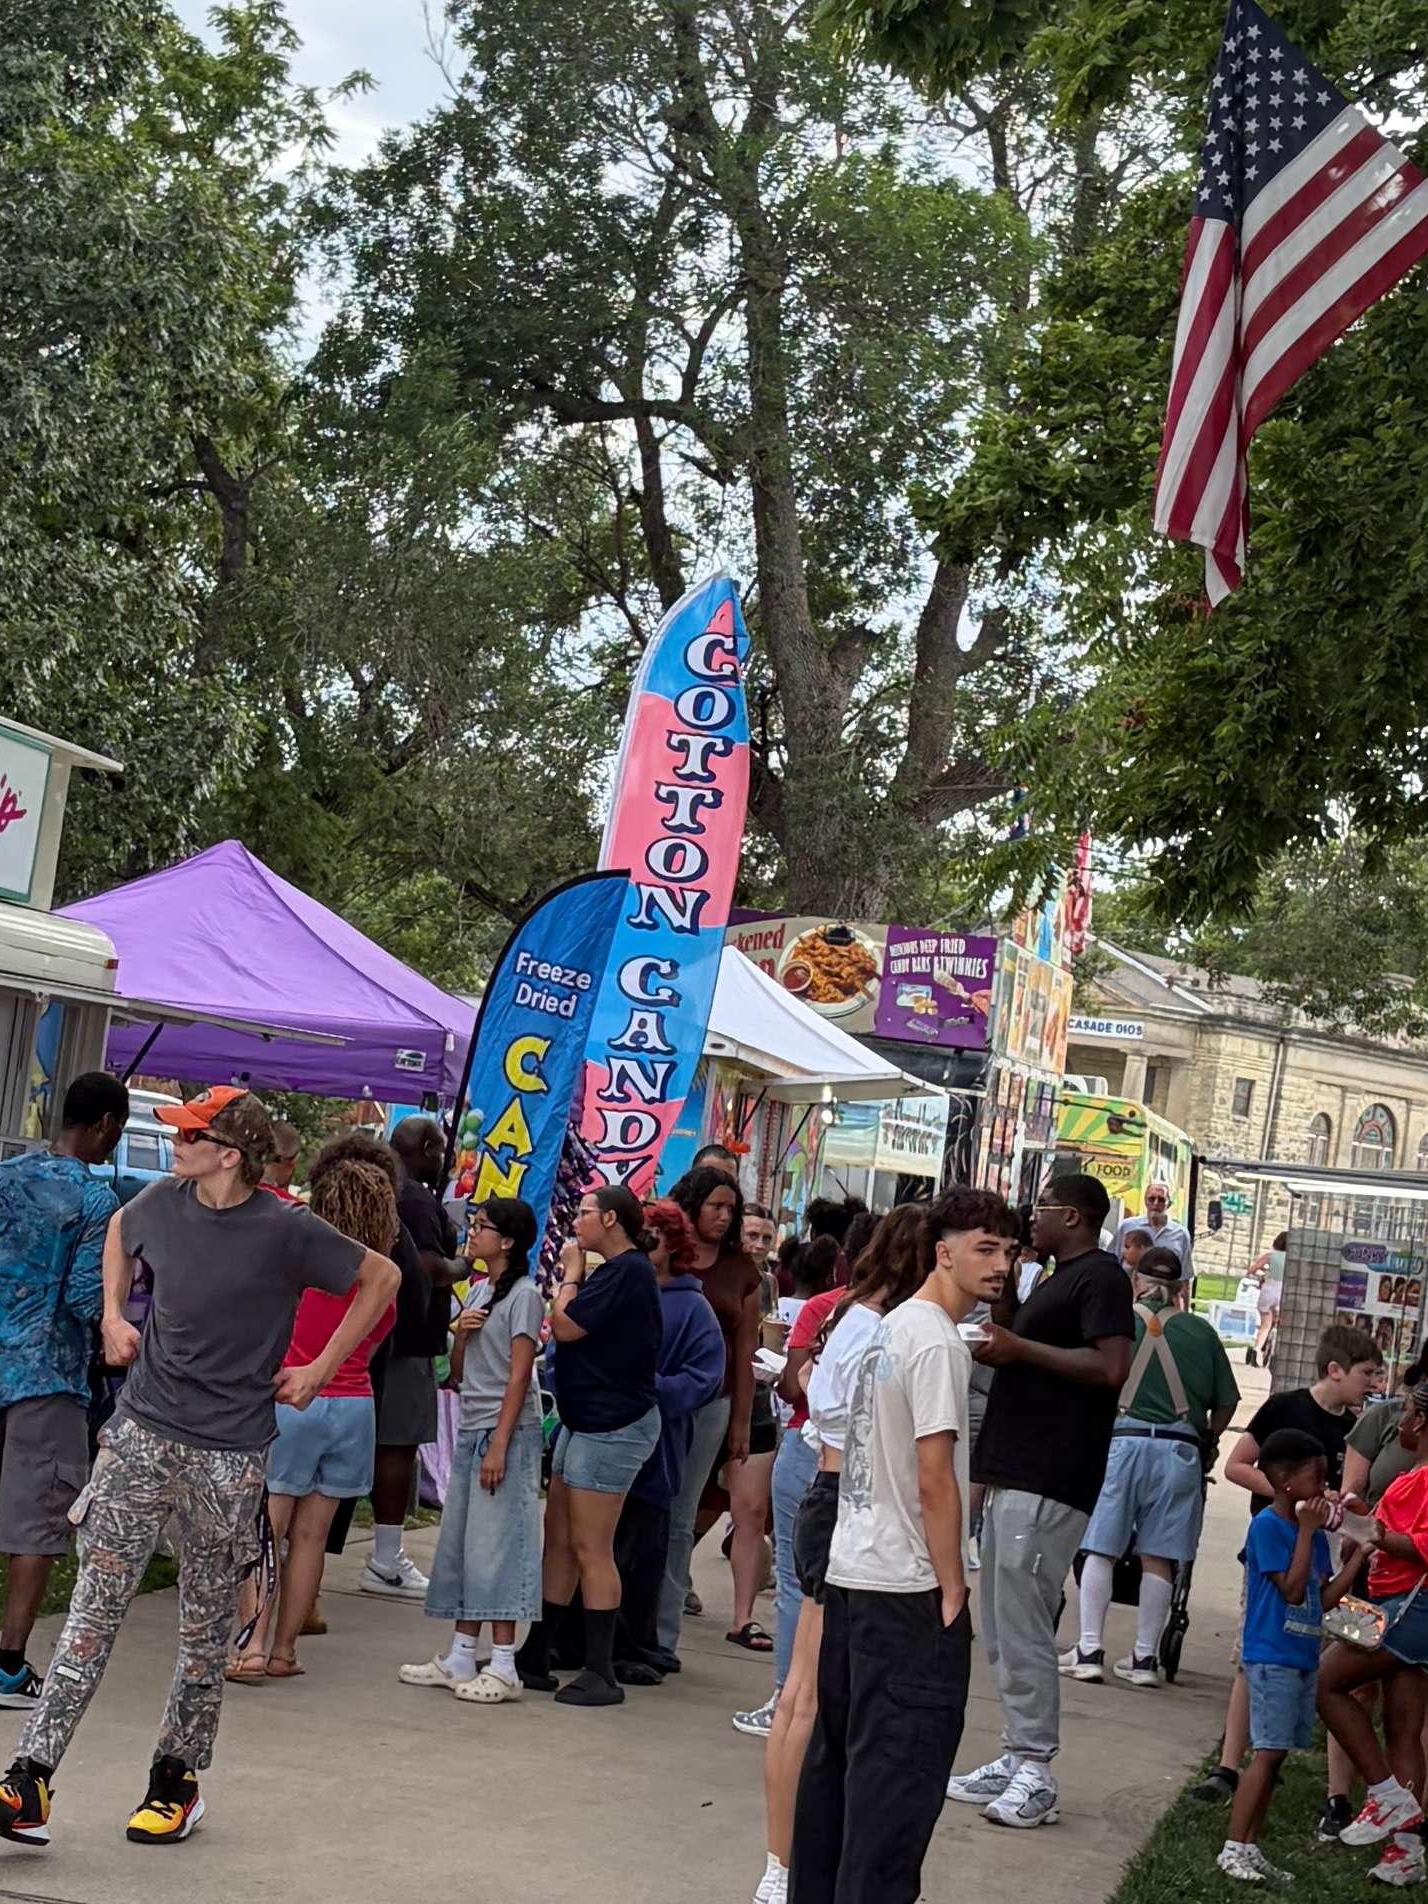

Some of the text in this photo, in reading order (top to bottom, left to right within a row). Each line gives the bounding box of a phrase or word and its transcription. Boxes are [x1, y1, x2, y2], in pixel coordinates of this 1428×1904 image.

[630, 631, 740, 936] COTTON
[940, 937, 966, 955] FRIED
[515, 951, 592, 992] Freeze
[515, 982, 577, 1018] Dried
[1115, 1023, 1143, 1036] DIOS
[589, 953, 682, 1198] CANDY
